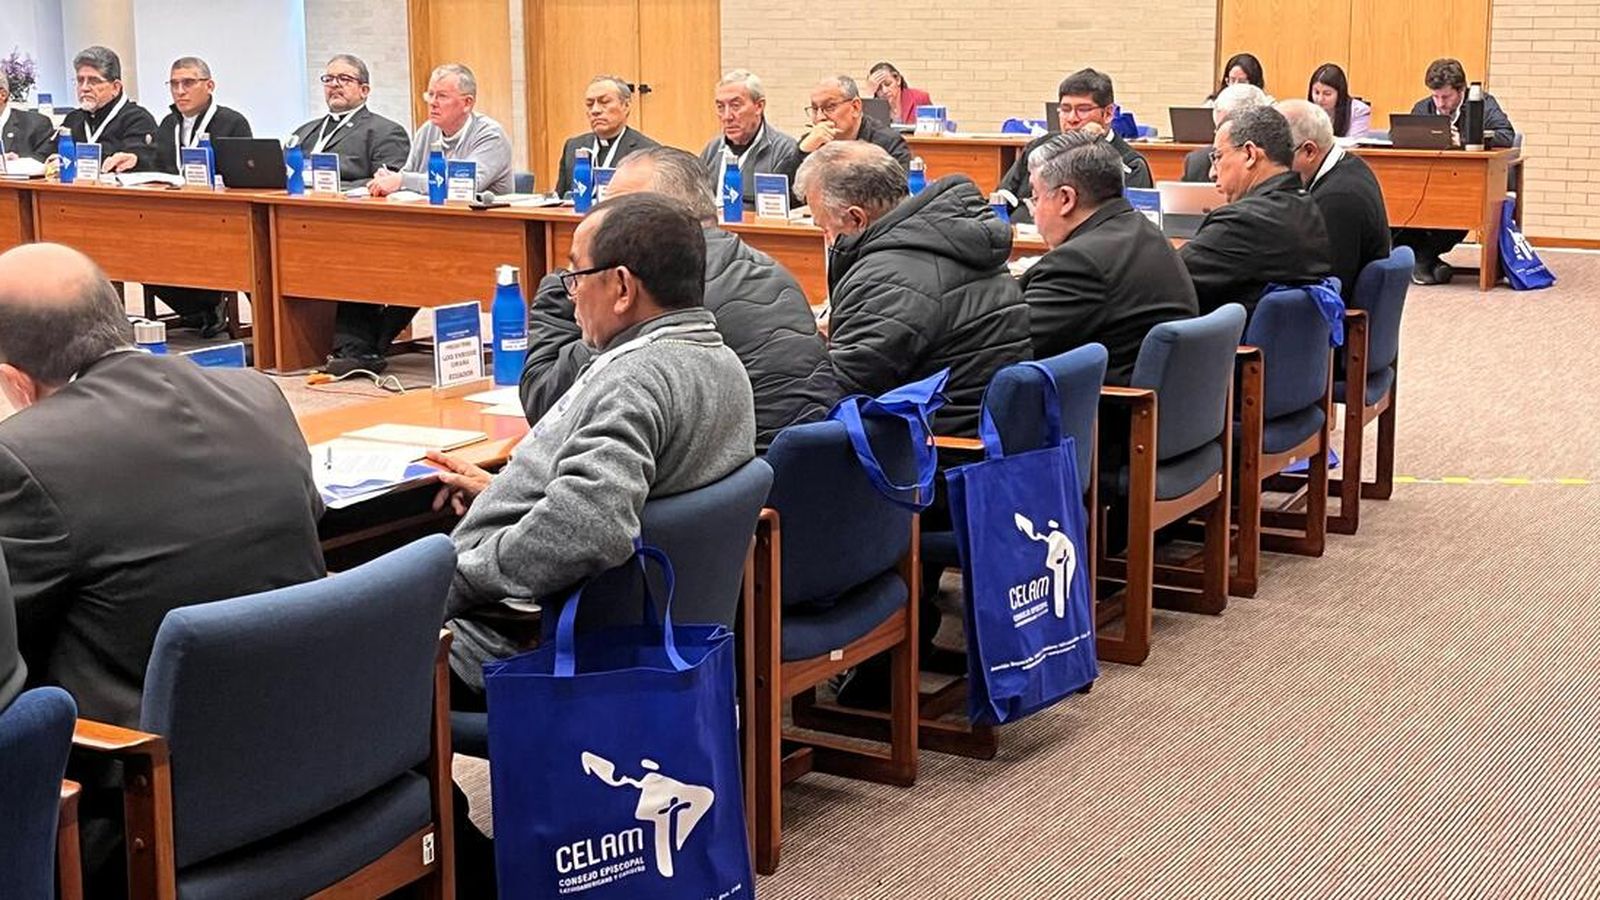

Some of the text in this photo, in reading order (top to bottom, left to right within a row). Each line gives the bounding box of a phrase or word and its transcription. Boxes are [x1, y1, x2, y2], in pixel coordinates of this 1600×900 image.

[1009, 576, 1049, 609] CELAM
[556, 827, 643, 873] CELAM
[559, 856, 645, 887] CONSEJO EPISCOPAL
